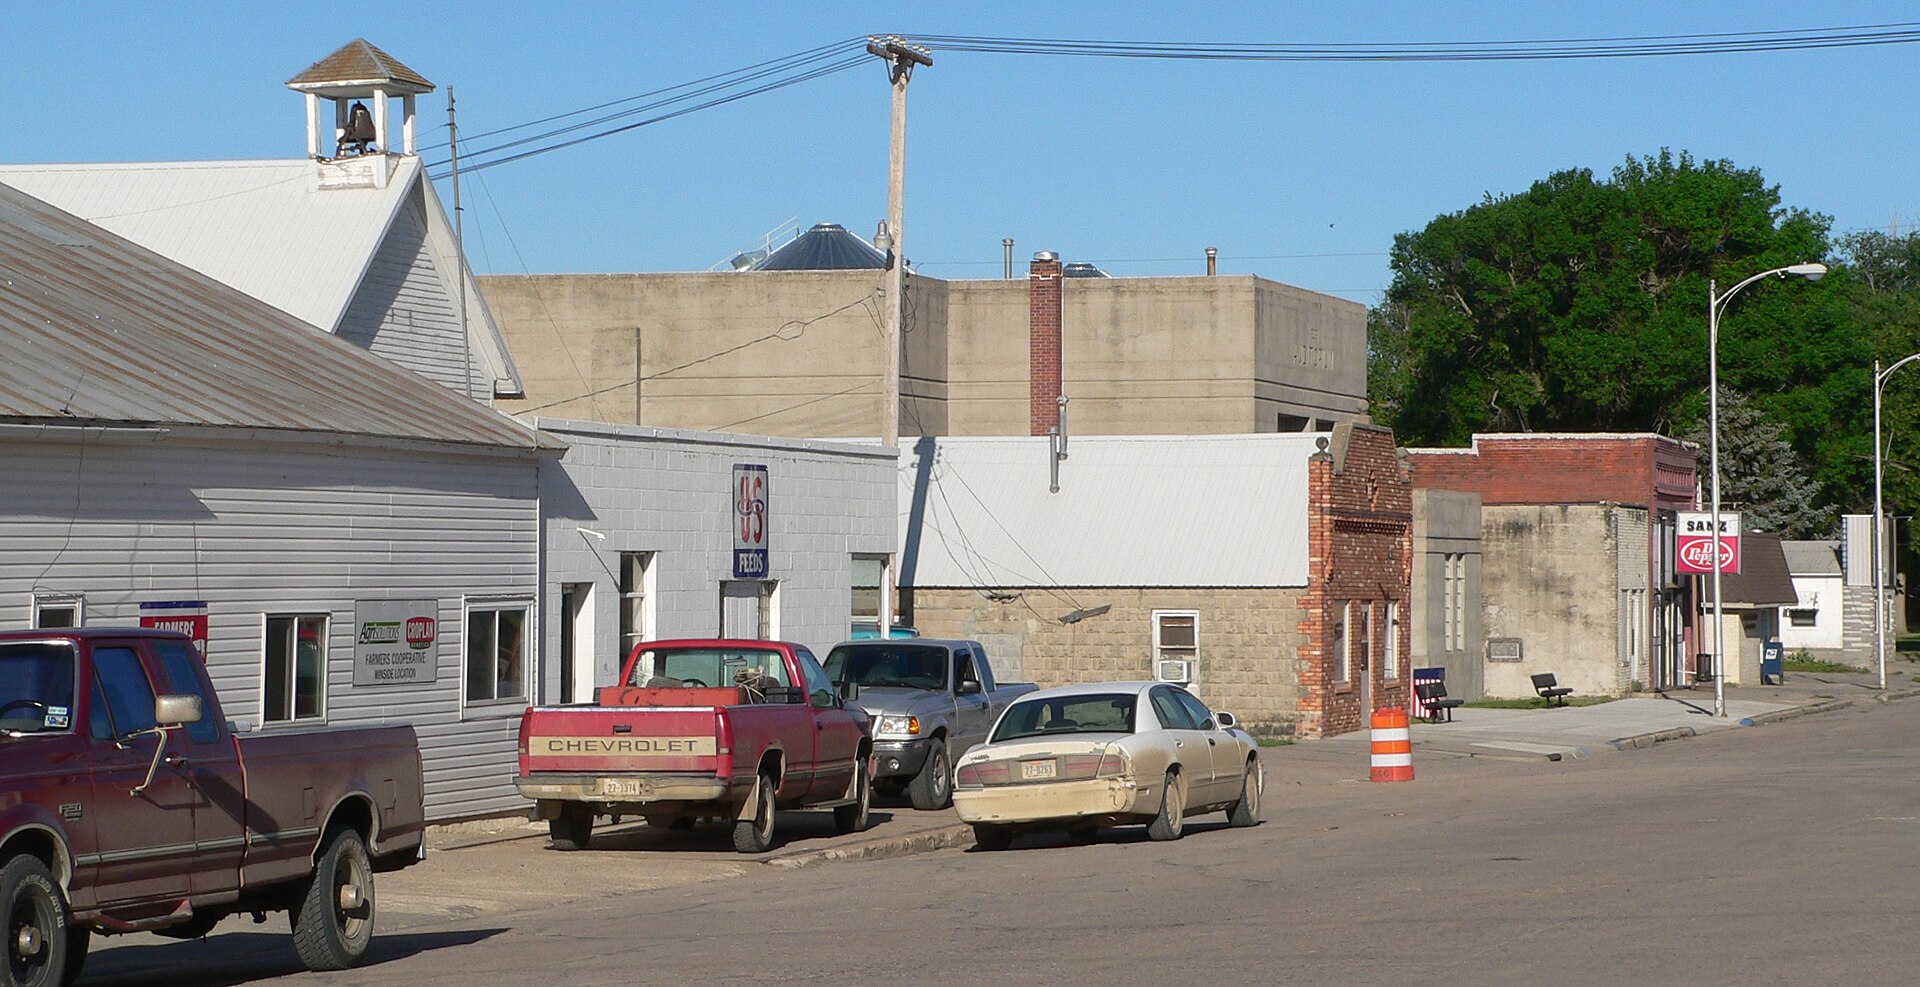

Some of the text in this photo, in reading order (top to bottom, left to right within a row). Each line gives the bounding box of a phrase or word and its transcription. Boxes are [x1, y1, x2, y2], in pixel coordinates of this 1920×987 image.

[739, 553, 763, 572] FEEDS
[1687, 548, 1729, 565] Pepr
[408, 622, 433, 638] CROPLAN
[366, 652, 426, 665] FARMERS COOPERATIVE
[374, 668, 416, 679] WINSIDE LOCATION
[549, 740, 697, 752] CHEVROLET
